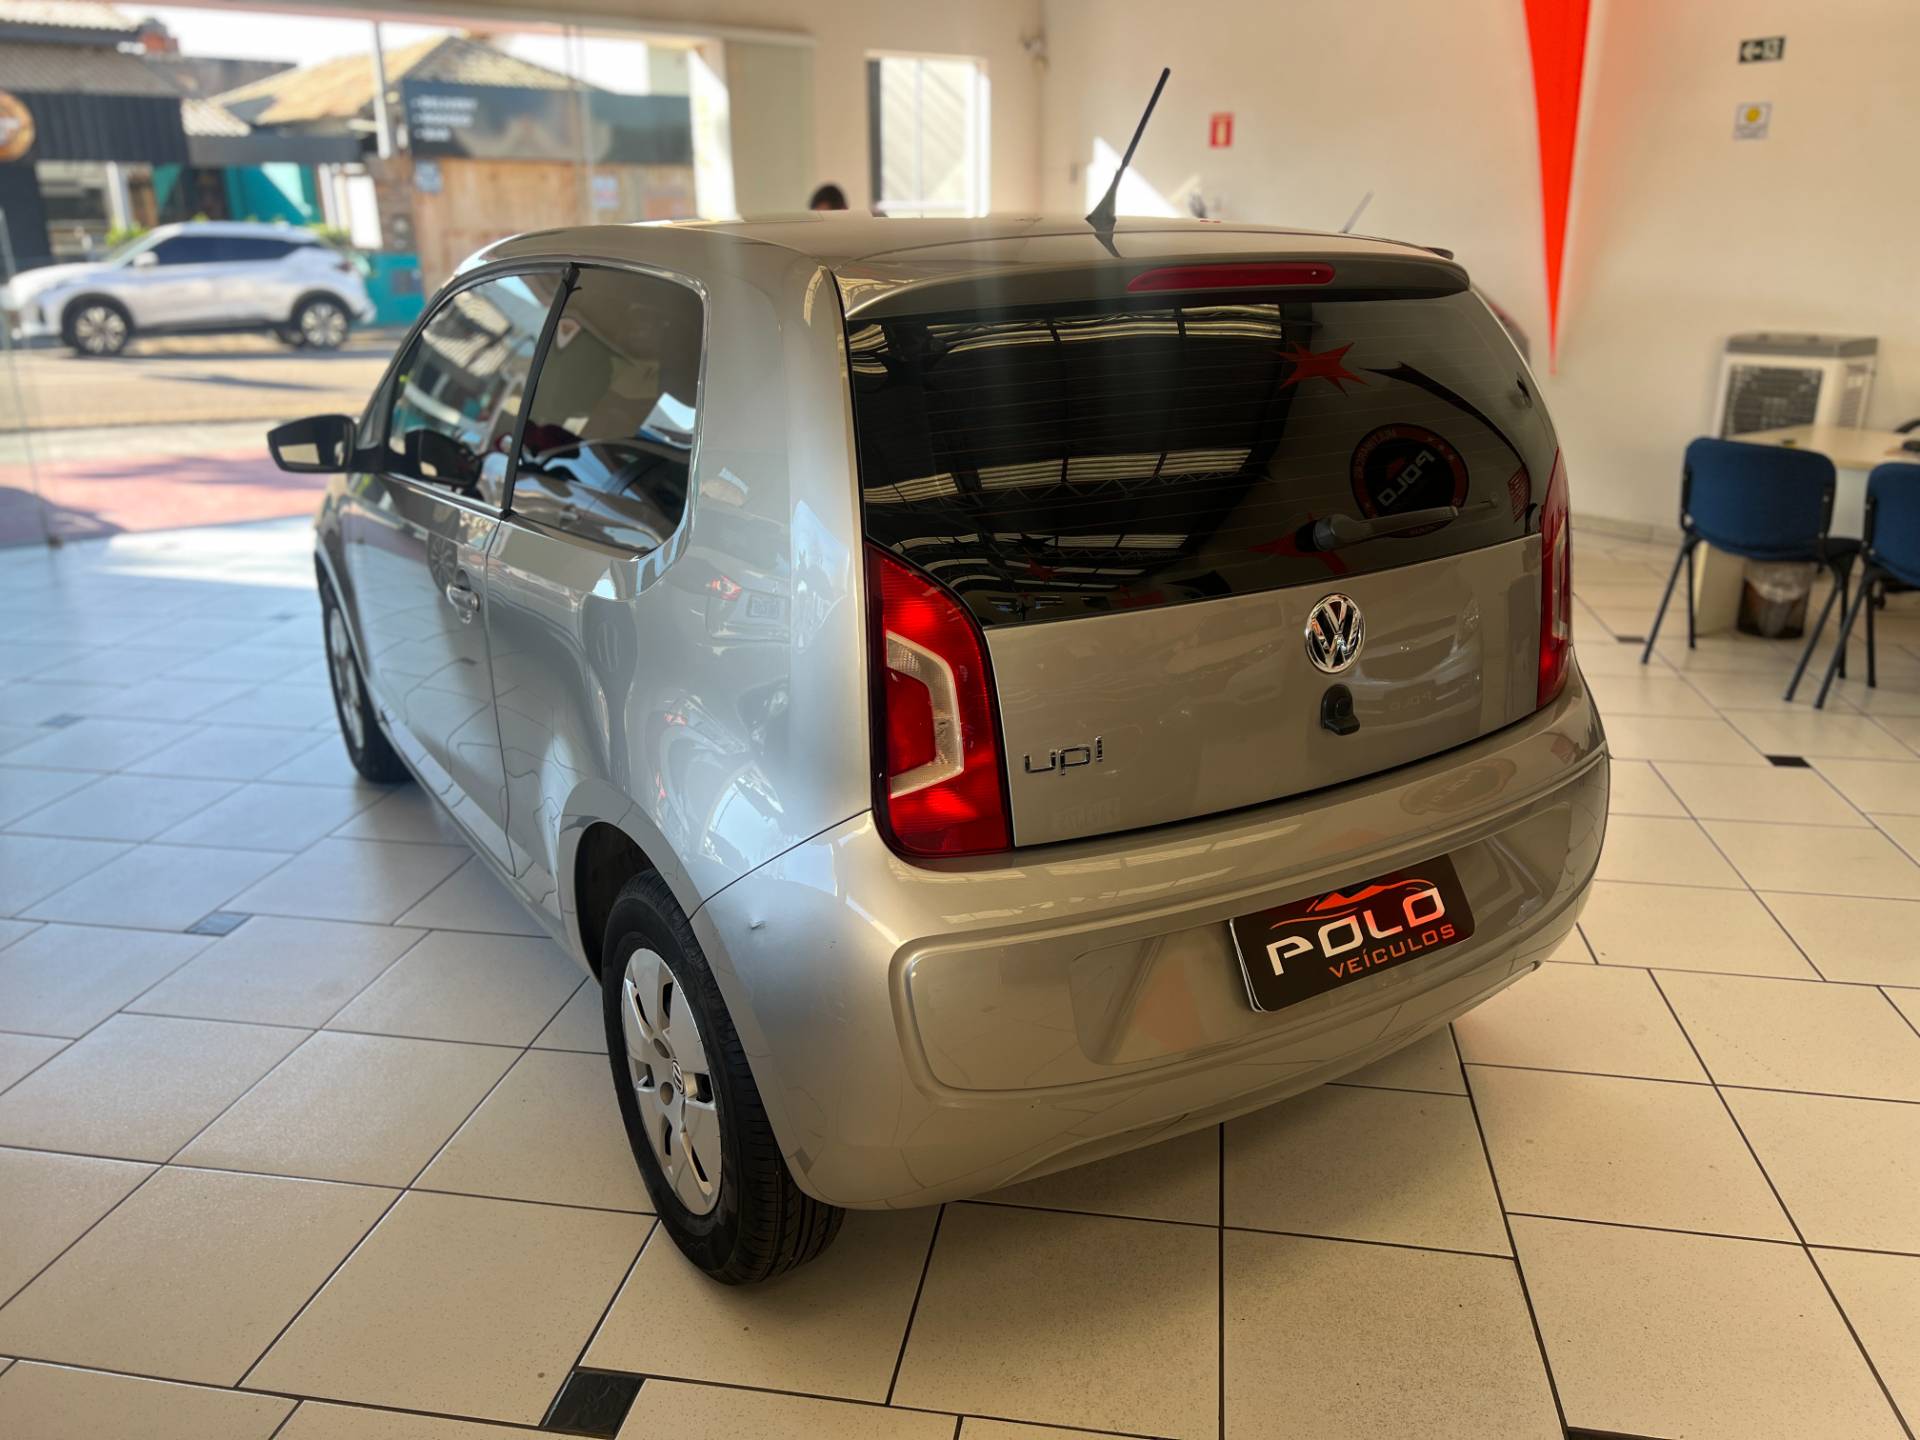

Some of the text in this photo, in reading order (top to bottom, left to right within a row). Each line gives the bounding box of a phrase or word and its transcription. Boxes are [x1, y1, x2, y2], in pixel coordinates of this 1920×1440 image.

[1024, 735, 1103, 776] up!
[1266, 887, 1446, 977] POLO
[1328, 923, 1456, 979] VEÍCULOS
